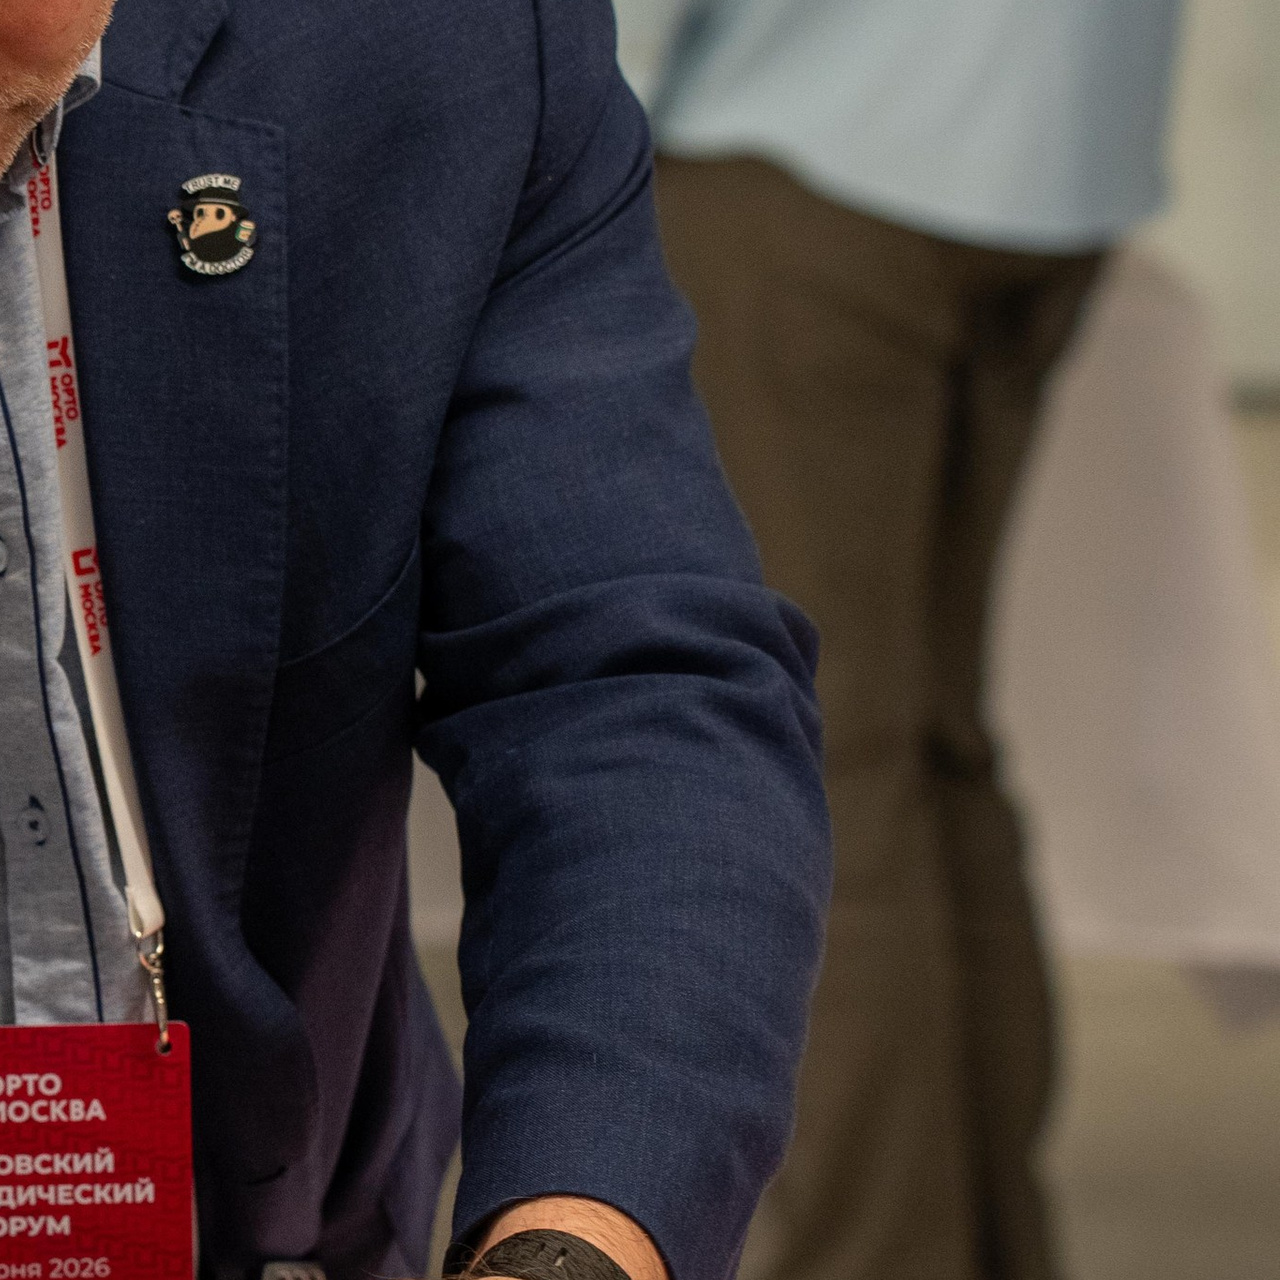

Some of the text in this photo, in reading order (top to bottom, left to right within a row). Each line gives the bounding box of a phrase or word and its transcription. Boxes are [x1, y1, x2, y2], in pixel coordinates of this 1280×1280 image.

[27, 176, 41, 237] ОСКВА
[184, 175, 239, 192] TRUST ME
[60, 373, 79, 421] ОРТО
[79, 584, 102, 656] МОСКВА
[48, 1257, 112, 1279] 2026
